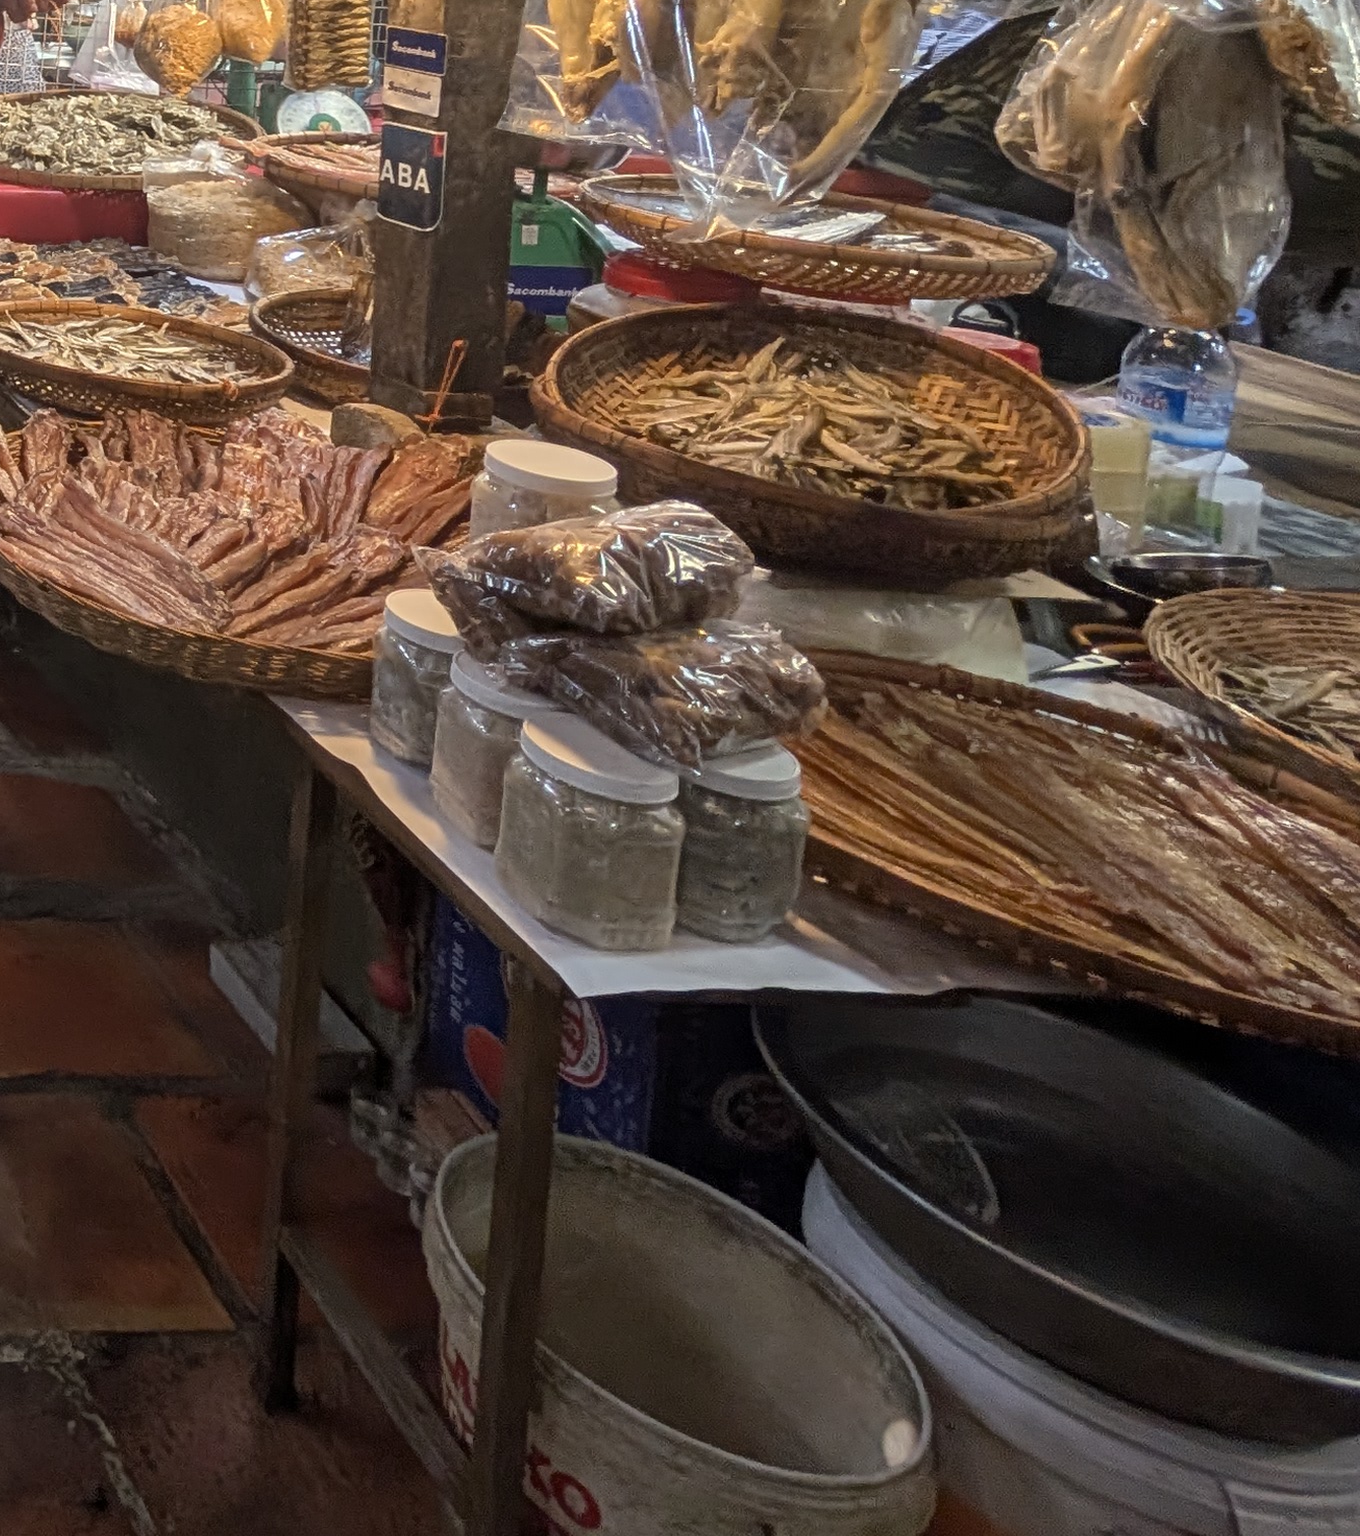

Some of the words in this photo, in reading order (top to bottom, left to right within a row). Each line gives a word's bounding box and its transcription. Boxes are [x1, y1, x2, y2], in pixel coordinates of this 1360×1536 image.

[391, 41, 437, 59] Sacombank
[388, 80, 432, 102] Sacombank
[380, 158, 431, 195] ABA
